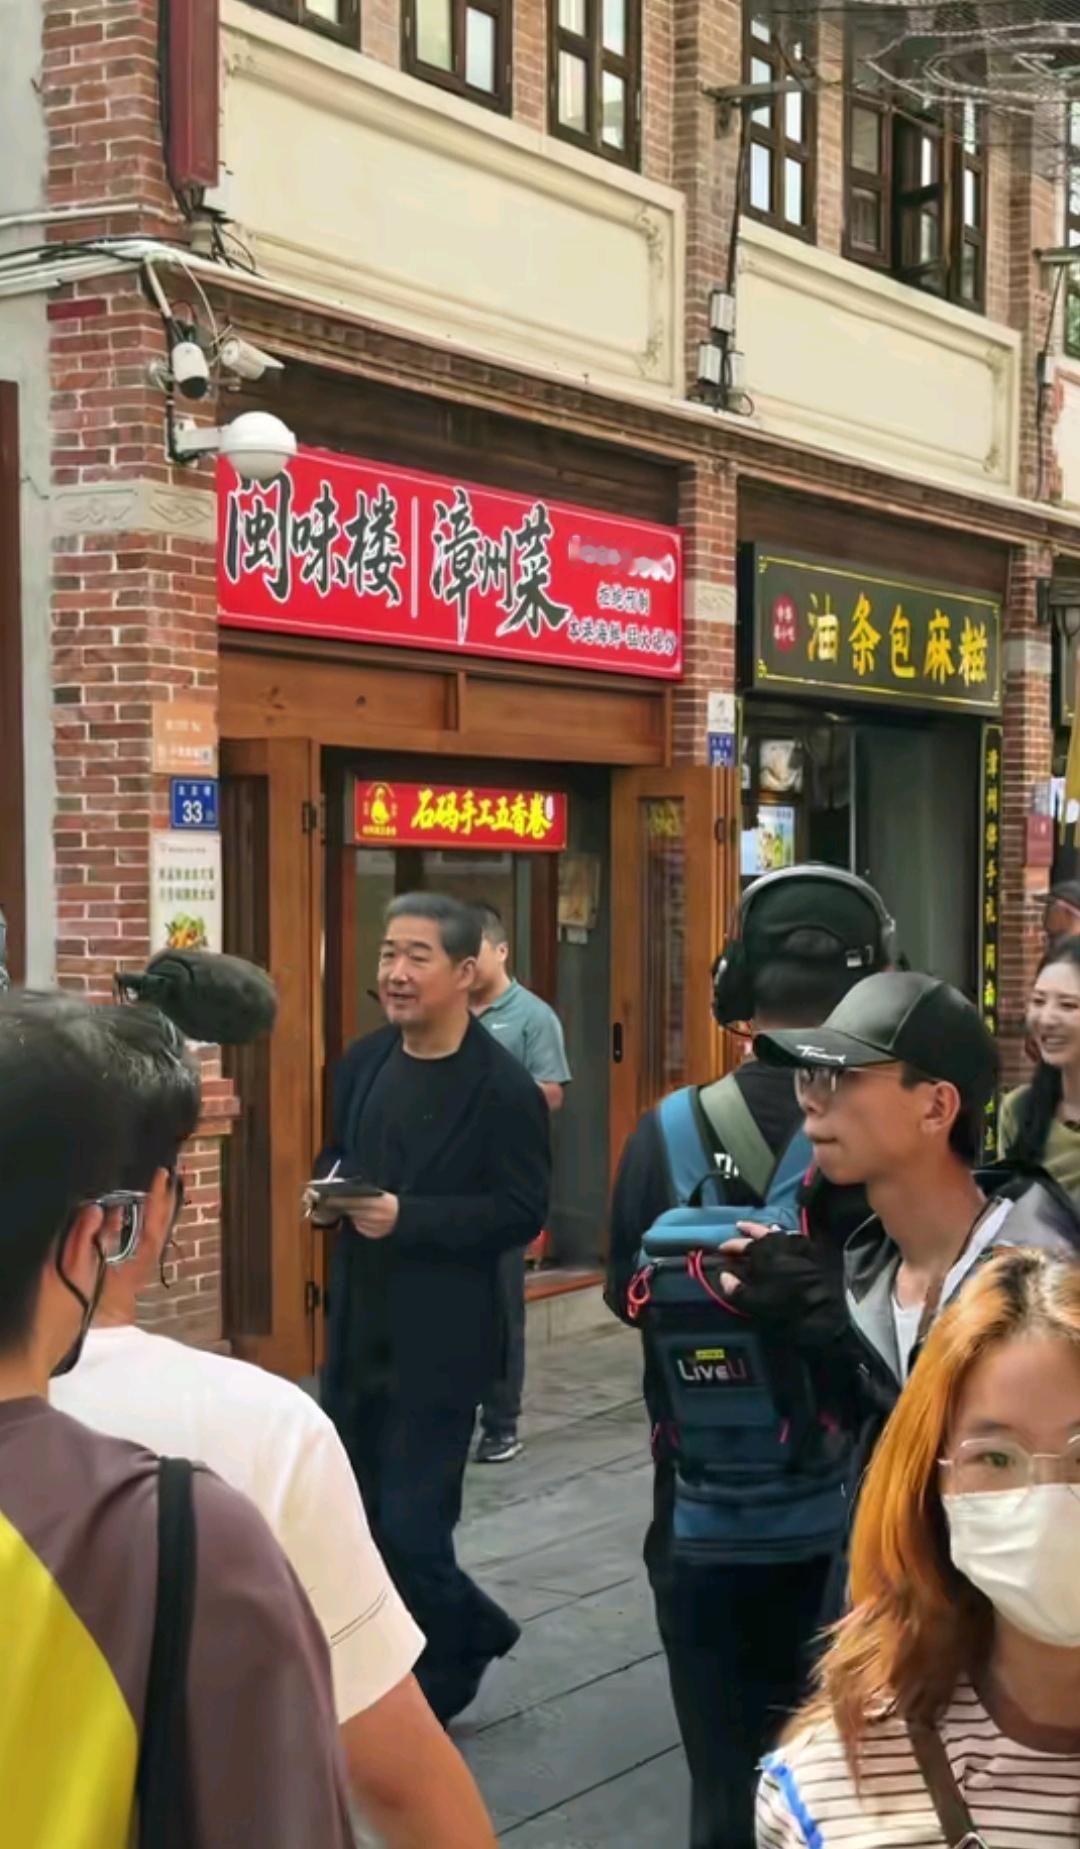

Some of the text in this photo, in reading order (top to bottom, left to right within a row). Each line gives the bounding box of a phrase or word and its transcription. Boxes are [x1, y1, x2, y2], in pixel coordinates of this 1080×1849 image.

[225, 469, 572, 646] 闽味楼 漳州菜
[182, 799, 203, 824] 33
[411, 788, 553, 839] 石码手工五香卷
